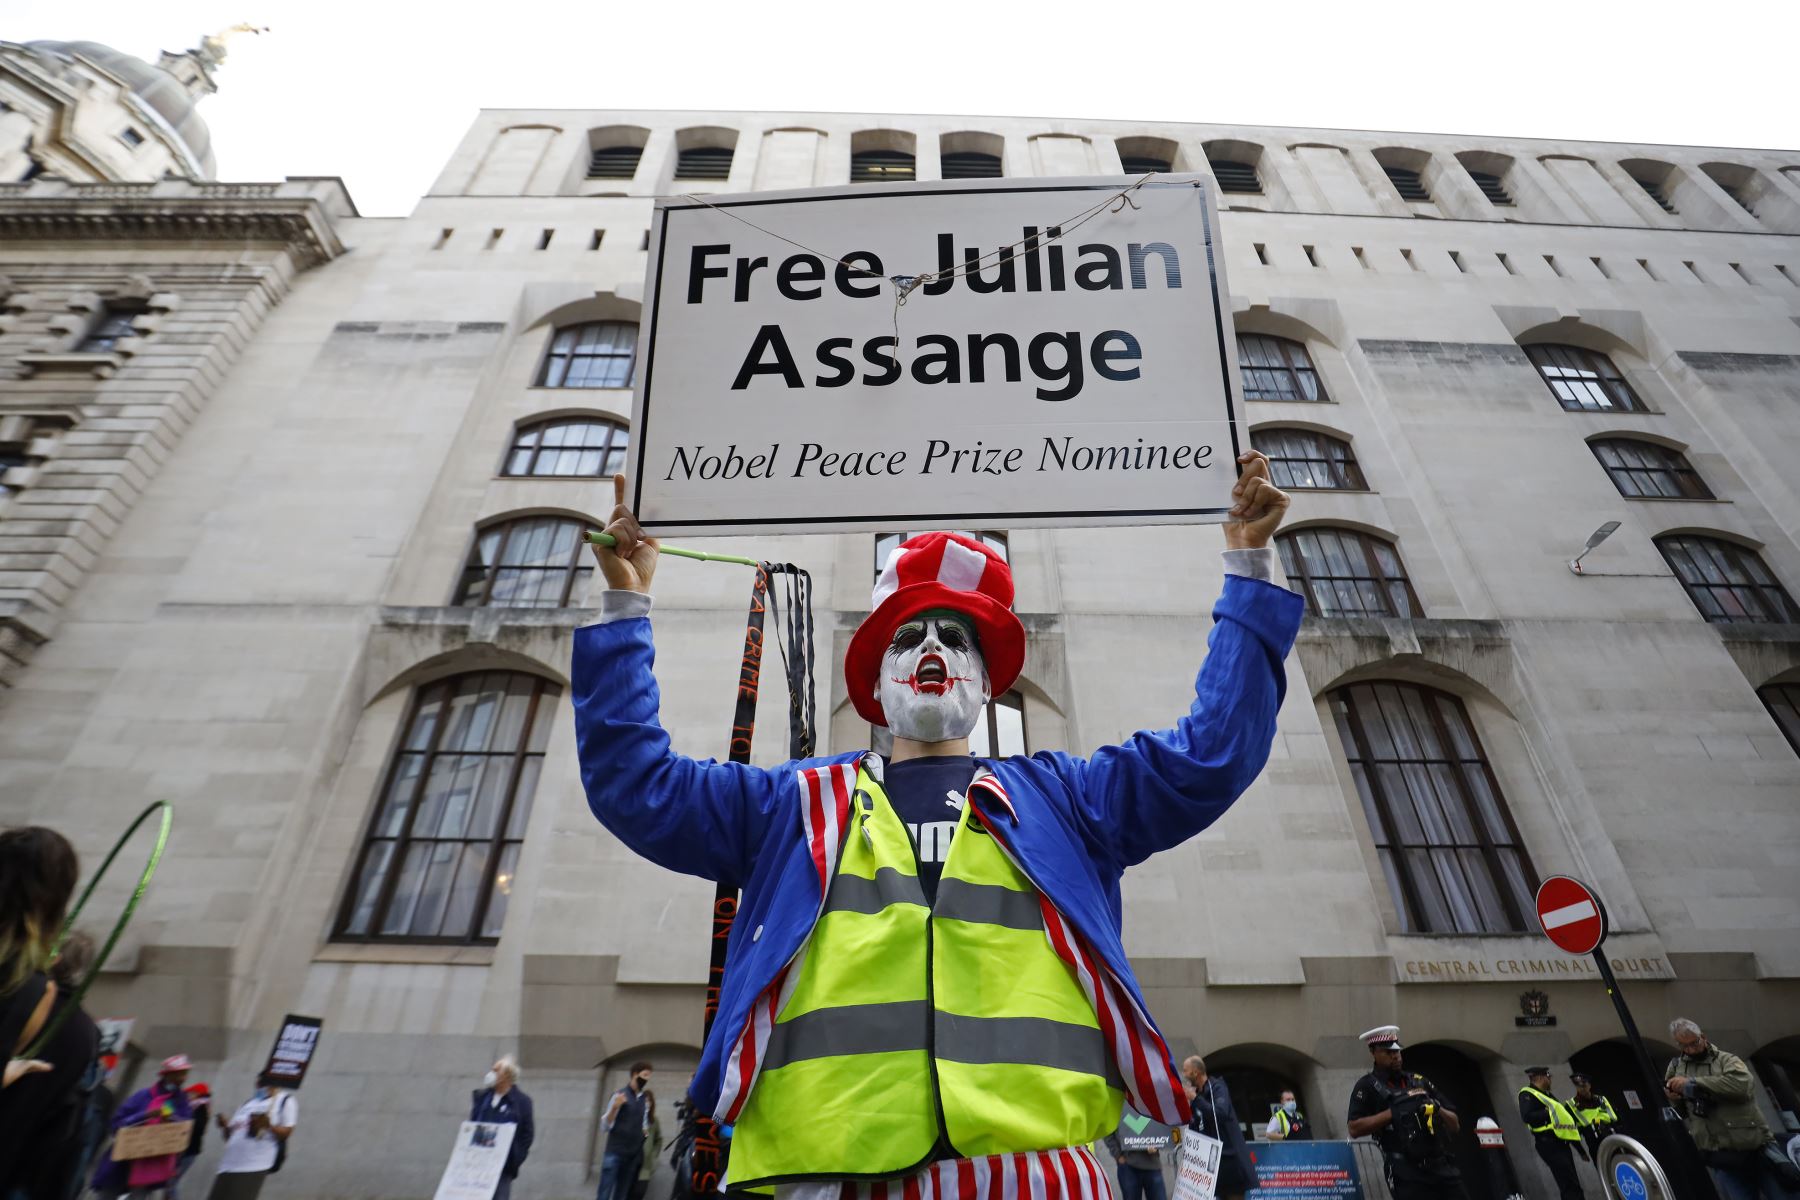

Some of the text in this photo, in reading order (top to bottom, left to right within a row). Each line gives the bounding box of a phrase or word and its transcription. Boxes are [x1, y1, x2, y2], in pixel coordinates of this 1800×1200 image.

[688, 225, 1182, 304] Free Julian
[731, 325, 1142, 401] Assange
[664, 436, 1213, 480] Nobel Peace Prize Nominee
[737, 626, 763, 703] CRIME
[729, 723, 755, 755] TO
[1406, 958, 1664, 976] CENTRAL CRIMINAL OURT
[1124, 1136, 1169, 1145] DEMOCRACY
[1192, 1139, 1200, 1151] US
